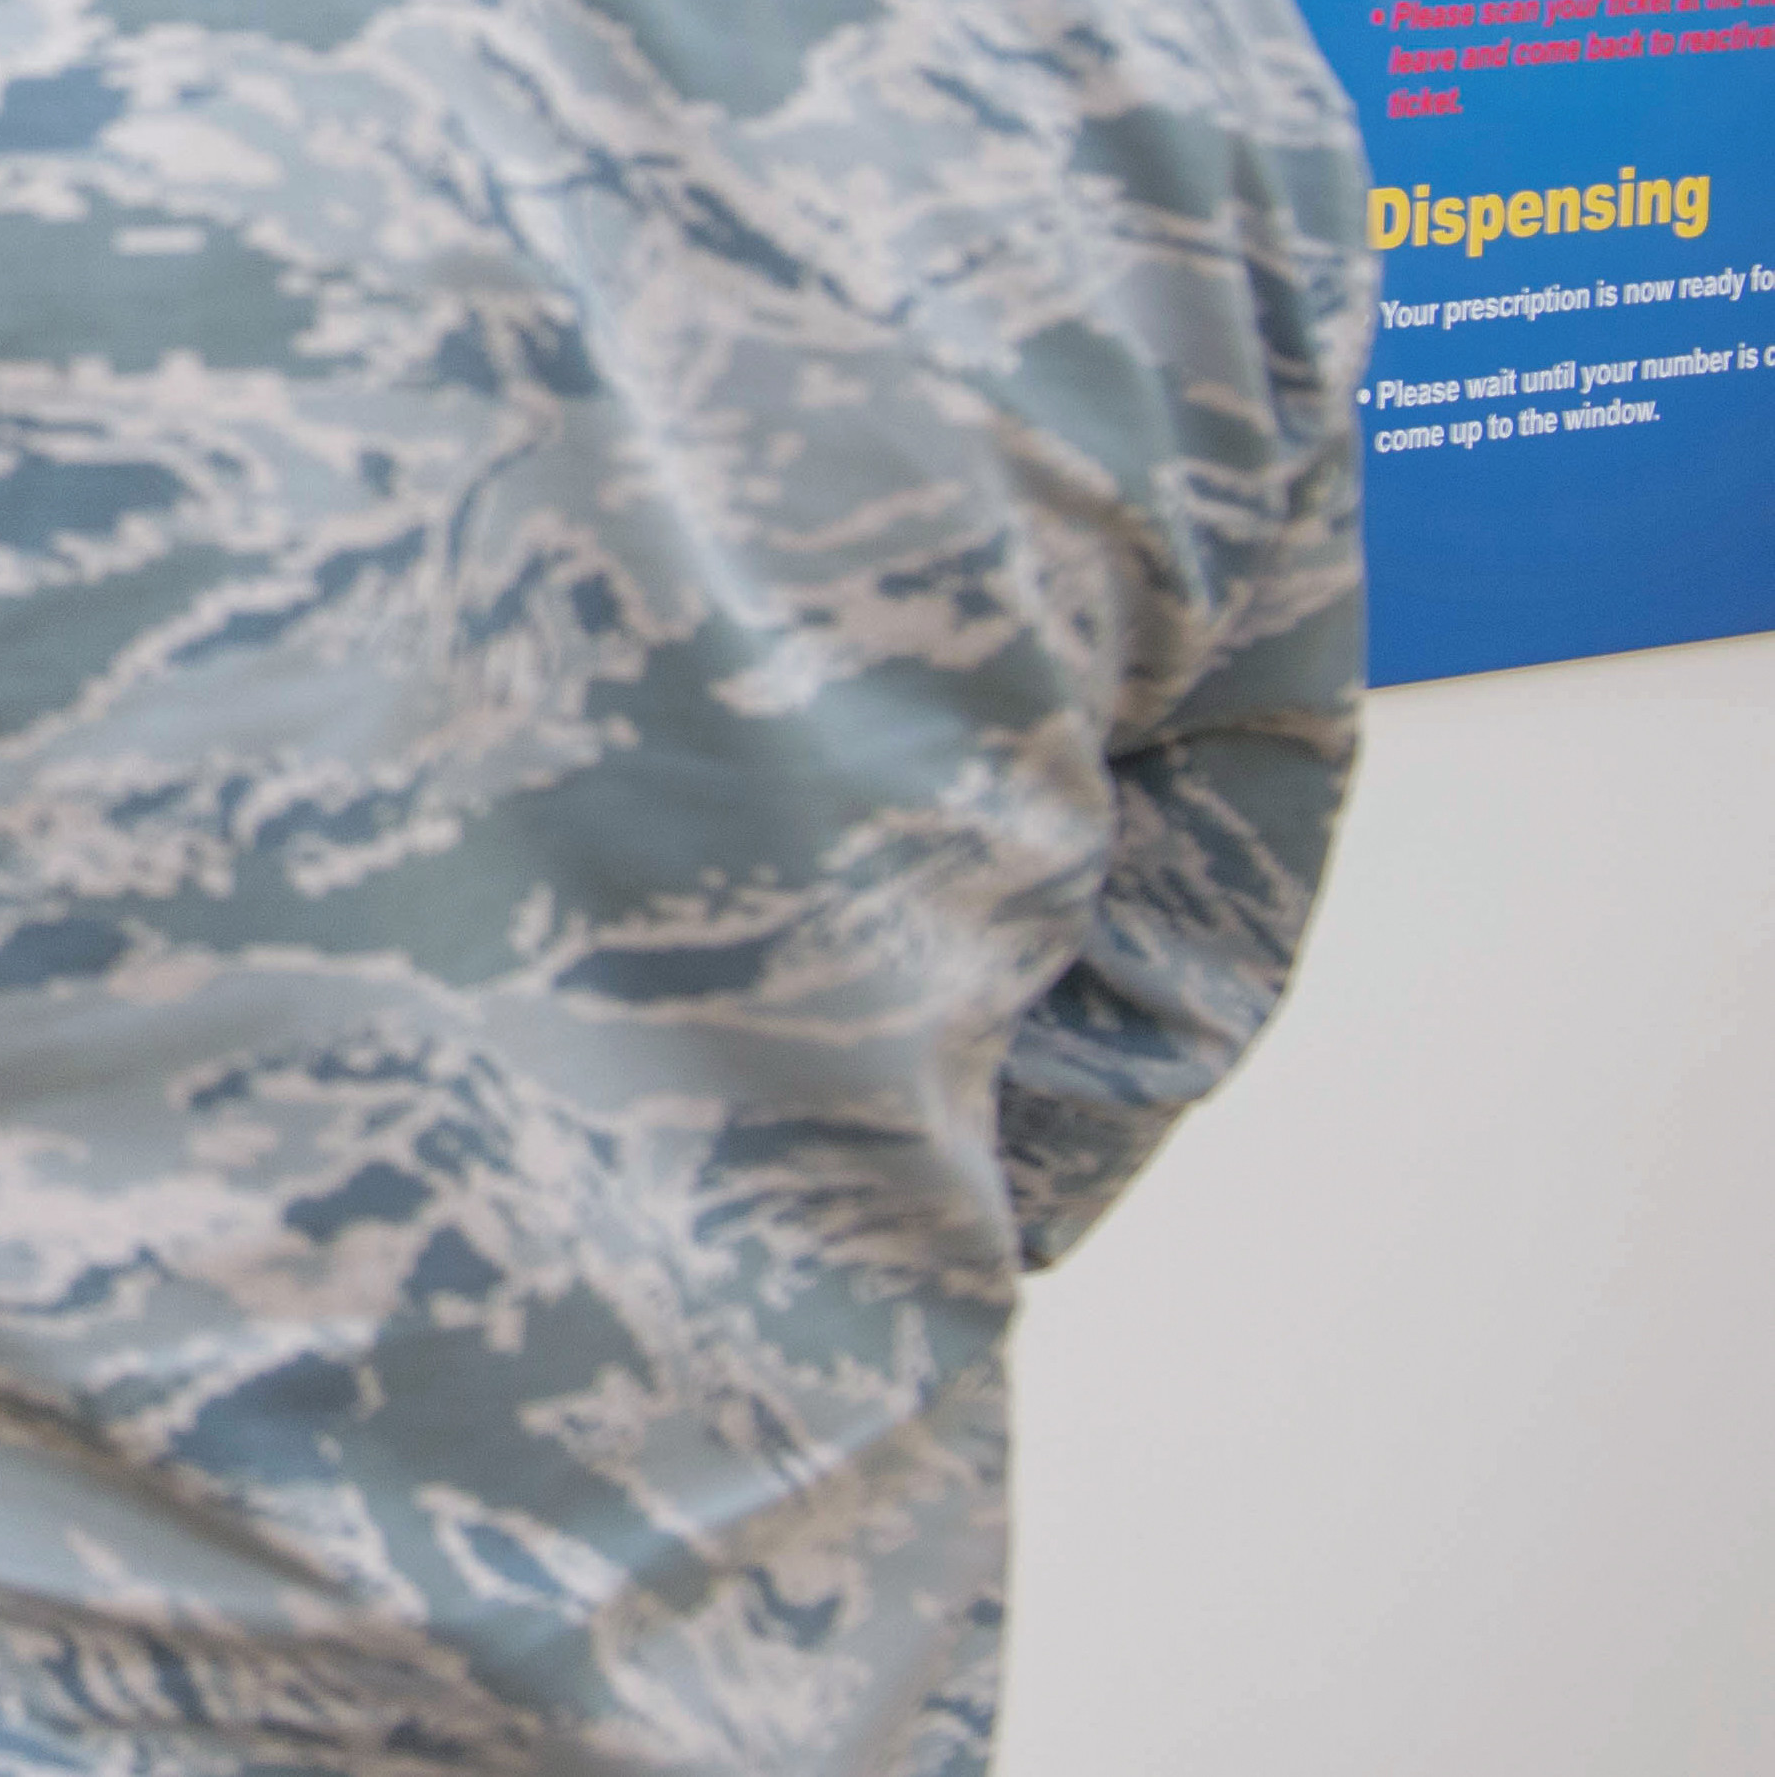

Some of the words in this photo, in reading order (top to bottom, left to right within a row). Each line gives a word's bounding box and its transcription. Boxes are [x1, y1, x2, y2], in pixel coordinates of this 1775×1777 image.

[1390, 0, 1476, 31] Please
[1388, 45, 1457, 75] leave
[1461, 38, 1510, 70] and
[1513, 38, 1581, 67] come
[1586, 30, 1646, 62] back
[1649, 31, 1676, 58] to
[1678, 21, 1775, 57] reactiva
[1387, 87, 1464, 120] ticket.
[1367, 166, 1710, 259] Dispensing
[1379, 300, 1440, 330] Your
[1442, 286, 1590, 330] prescription
[1595, 279, 1619, 308] is
[1622, 277, 1675, 305] now
[1678, 266, 1746, 303] ready
[1749, 263, 1775, 293] fo
[1375, 378, 1461, 411] Please
[1463, 367, 1518, 400] wait
[1521, 360, 1577, 395] until
[1579, 359, 1637, 395] your
[1640, 347, 1734, 381] number
[1737, 341, 1759, 371] is
[1374, 423, 1445, 454] come
[1449, 419, 1484, 450] up
[1486, 413, 1514, 440] to
[1517, 407, 1559, 437] the
[1561, 398, 1661, 432] window.
